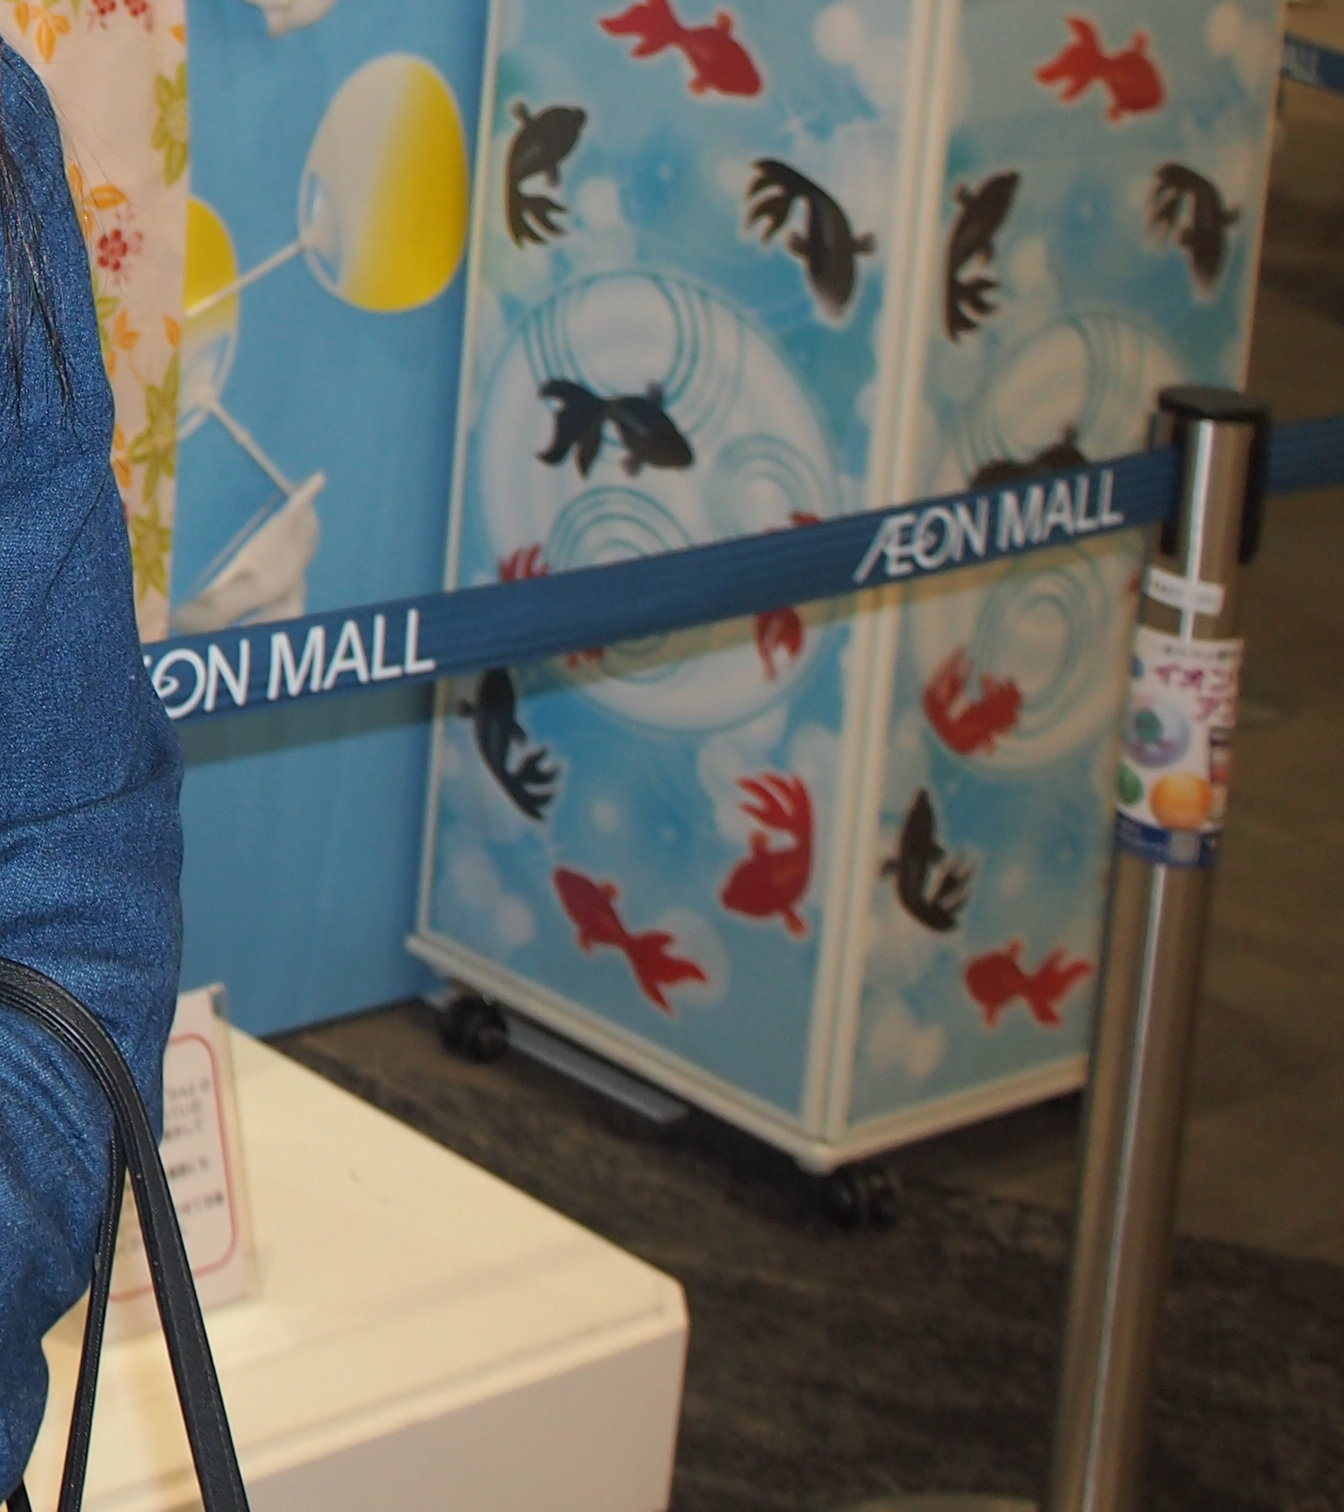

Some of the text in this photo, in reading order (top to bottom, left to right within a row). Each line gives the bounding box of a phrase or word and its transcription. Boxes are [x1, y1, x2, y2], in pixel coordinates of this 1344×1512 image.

[996, 468, 1124, 552] MALL
[144, 608, 437, 720] ON MALL
